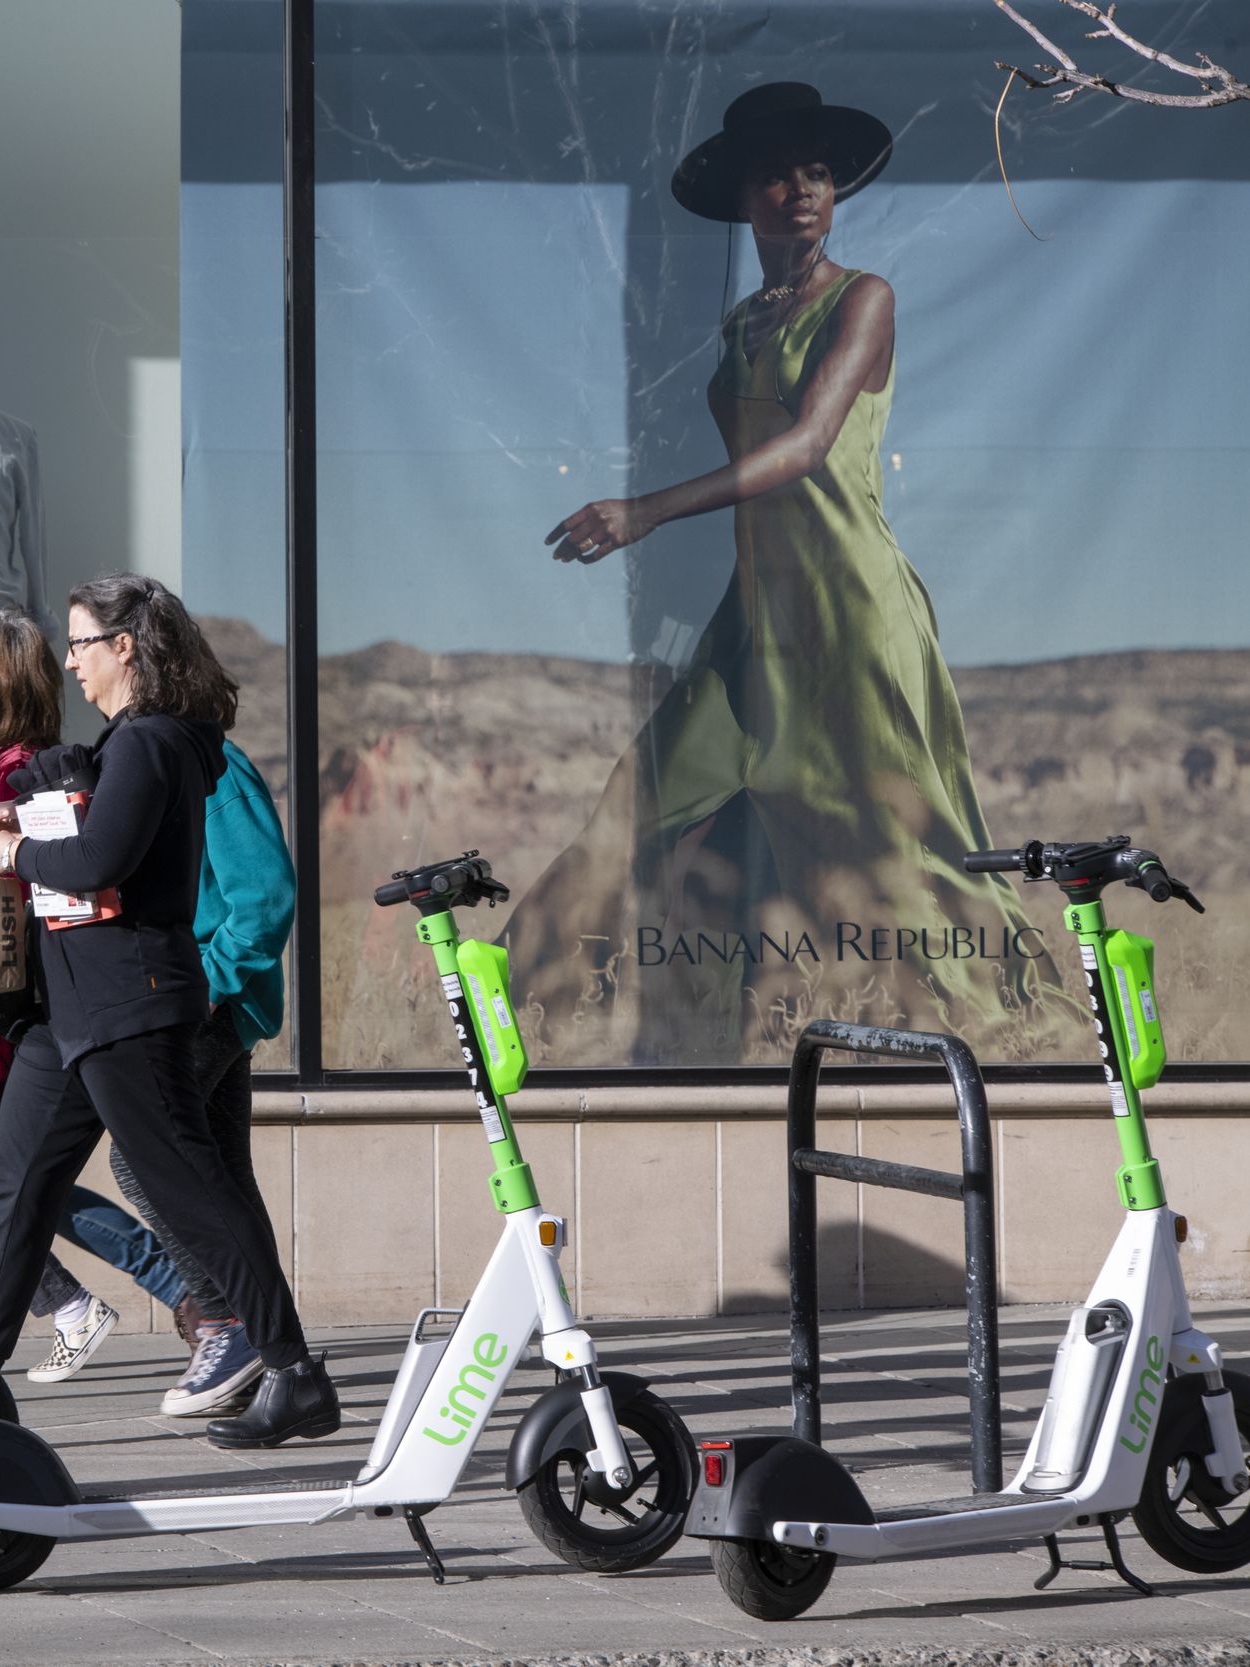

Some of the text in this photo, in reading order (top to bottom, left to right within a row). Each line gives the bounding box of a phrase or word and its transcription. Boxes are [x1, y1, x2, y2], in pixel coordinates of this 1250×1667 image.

[2, 896, 18, 967] LUSH
[637, 921, 1045, 967] BANANA REPUBLIC
[449, 1001, 488, 1109] 02374
[423, 1333, 508, 1447] Lime
[1121, 1335, 1164, 1455] Lime
